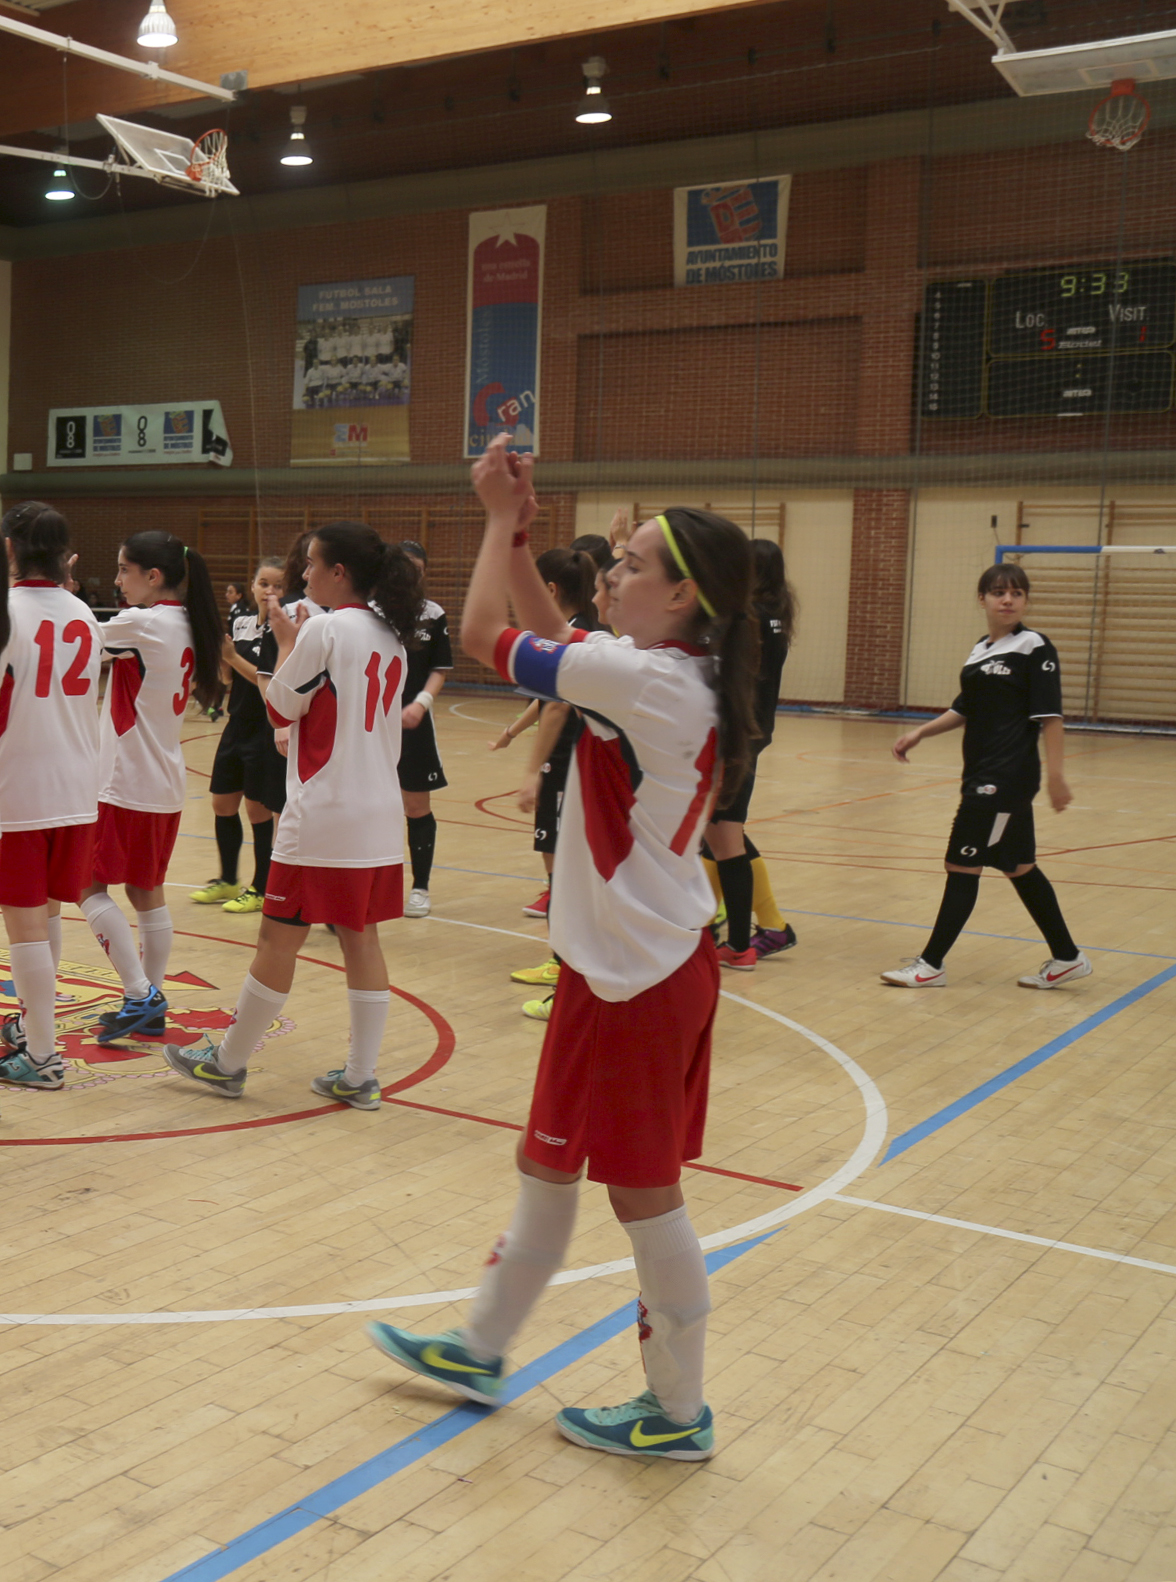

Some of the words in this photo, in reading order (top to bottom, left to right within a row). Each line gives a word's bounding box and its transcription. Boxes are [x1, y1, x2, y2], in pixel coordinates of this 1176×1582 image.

[686, 243, 778, 266] AYUNTAMIENTO
[685, 267, 703, 285] DE
[704, 260, 778, 284] MÓSTOLES
[1060, 272, 1129, 297] 9:33
[34, 619, 92, 698] 12
[172, 646, 195, 716] 3
